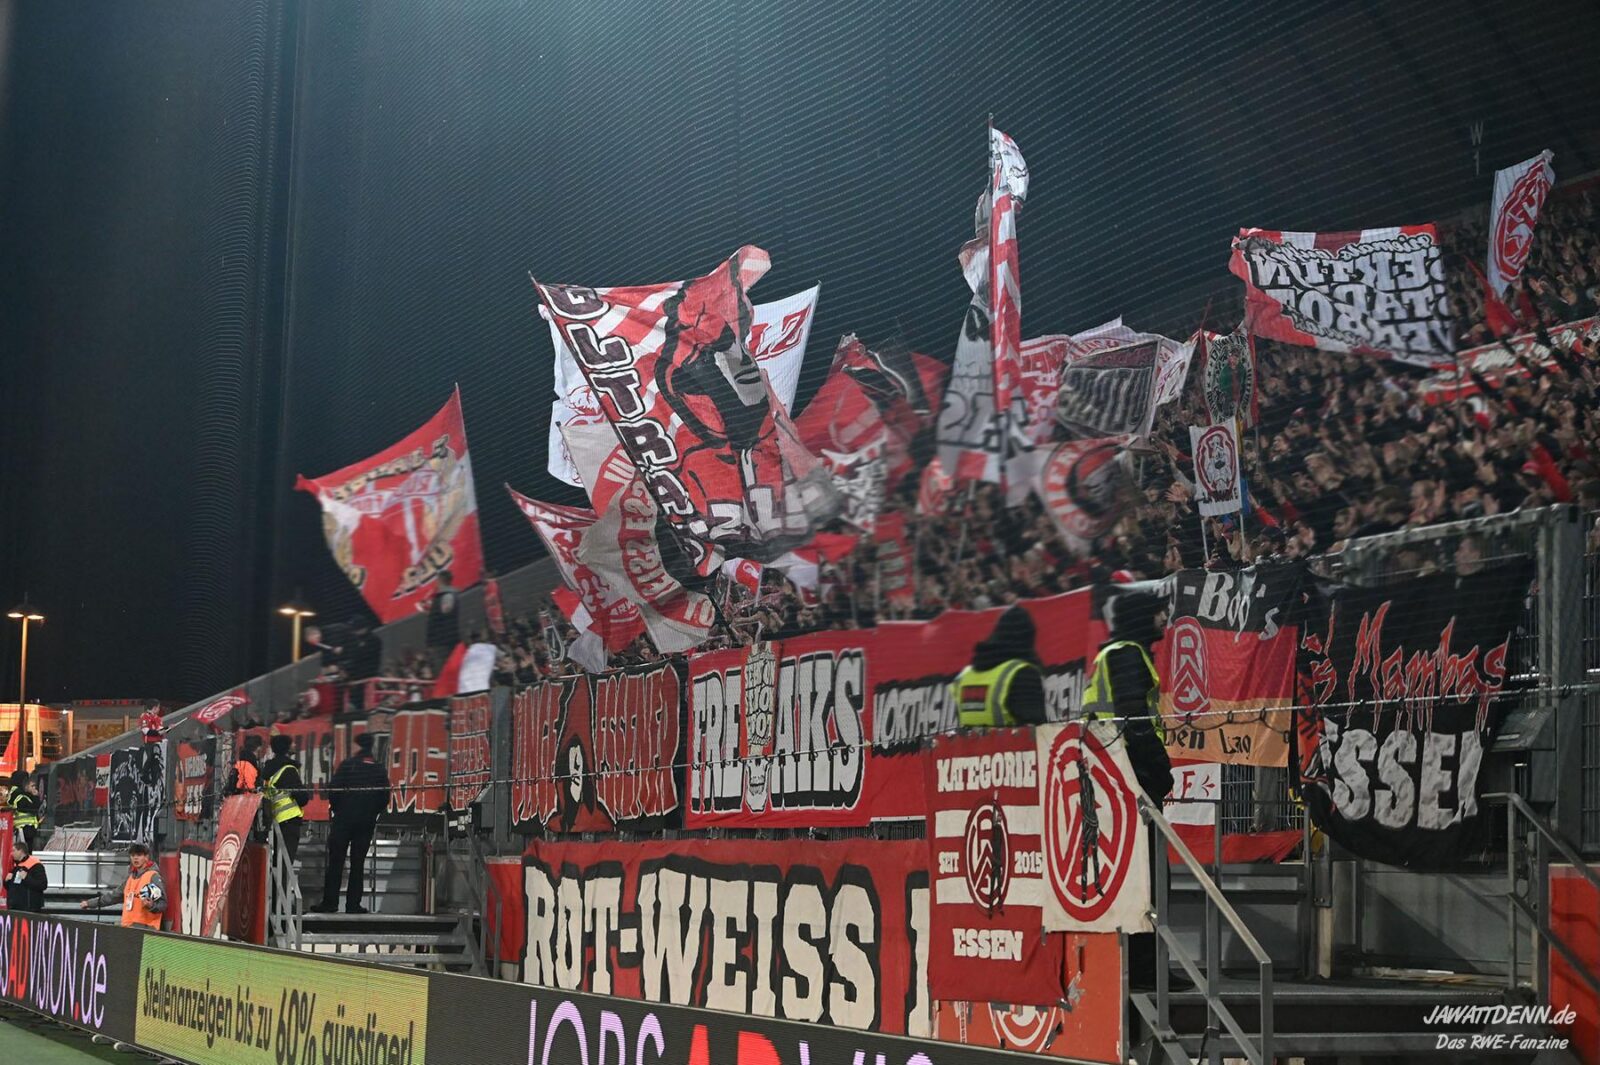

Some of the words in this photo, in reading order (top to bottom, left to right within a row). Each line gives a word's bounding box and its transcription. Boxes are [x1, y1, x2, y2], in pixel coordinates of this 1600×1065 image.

[873, 682, 959, 749] NORTHSID
[937, 751, 1036, 792] KATEGORIE
[938, 851, 959, 874] SEIT
[1014, 851, 1042, 874] 2015
[524, 865, 876, 1030] ROT-WEISS
[952, 928, 1023, 961] ESSEN
[143, 967, 233, 1048] Stellenanzeigen
[235, 985, 254, 1046] bis
[256, 1006, 273, 1051] zu
[275, 987, 316, 1065] 60%
